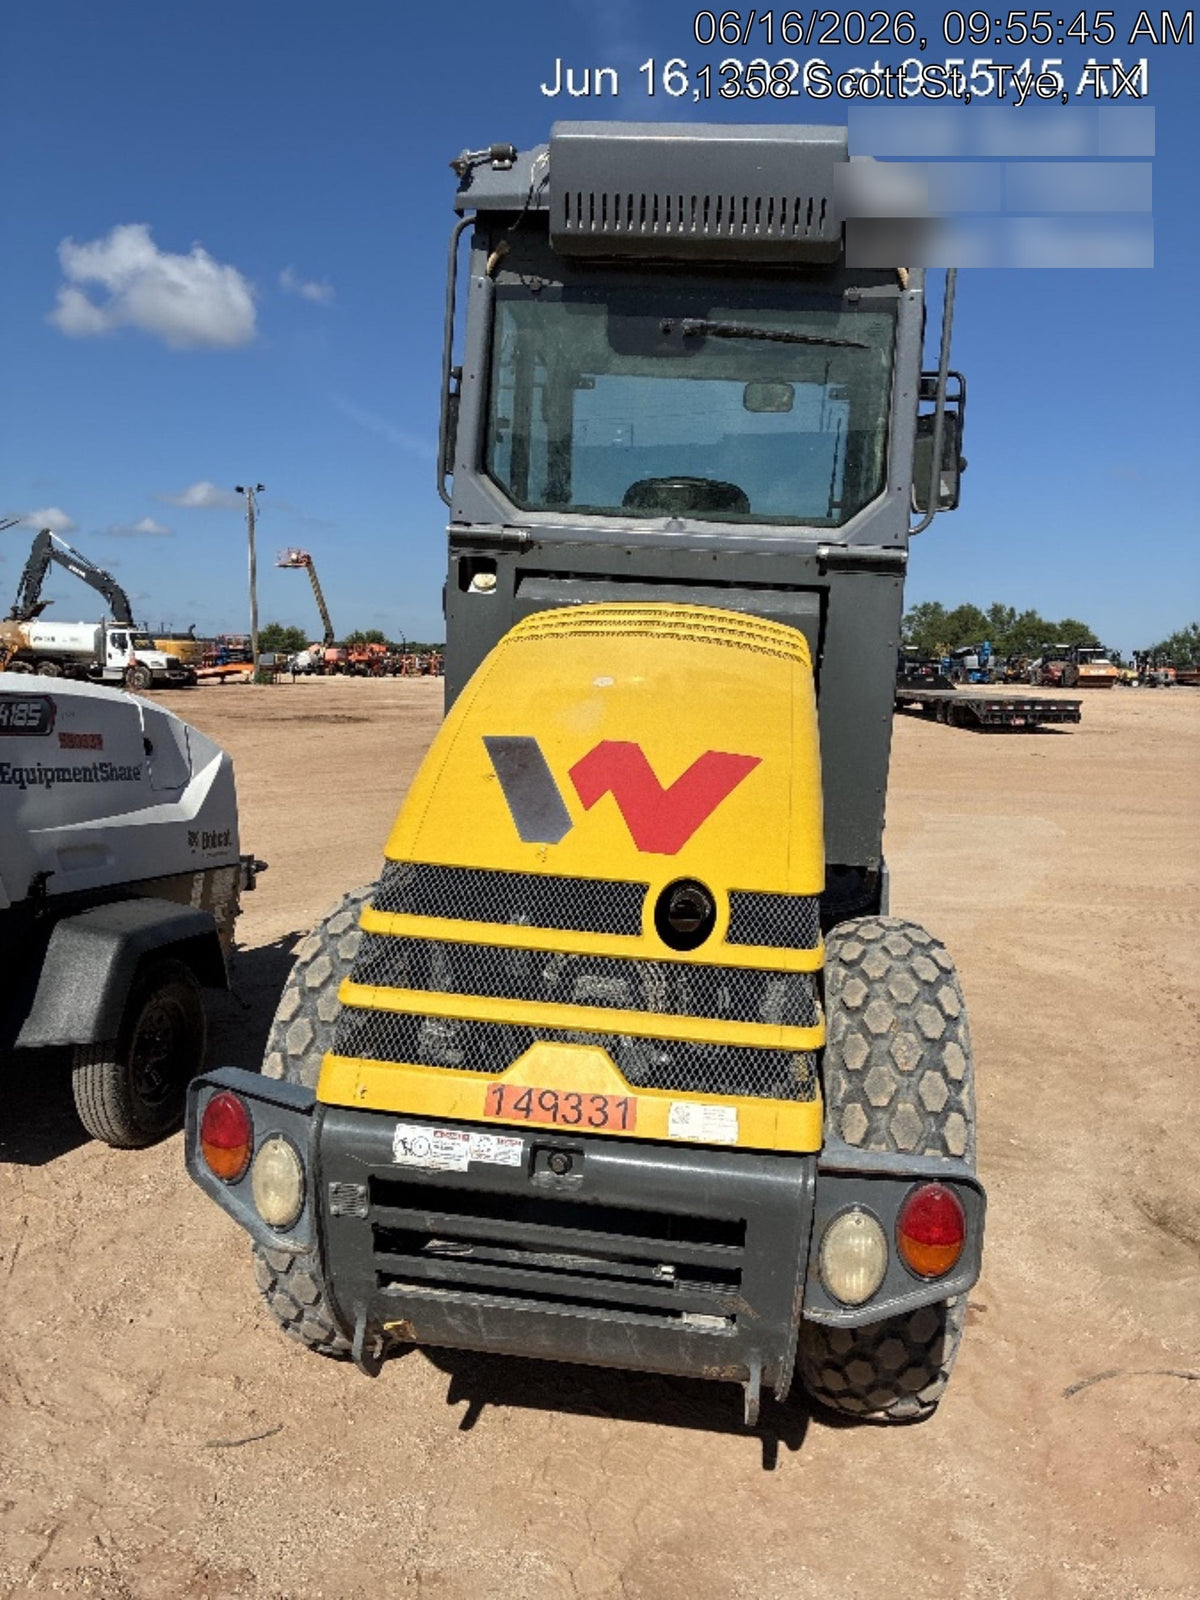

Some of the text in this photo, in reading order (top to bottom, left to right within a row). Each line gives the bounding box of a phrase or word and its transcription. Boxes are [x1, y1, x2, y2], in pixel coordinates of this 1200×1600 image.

[0, 762, 142, 790] EquipmentShare
[202, 828, 230, 849] Bobcat
[491, 1084, 630, 1129] 149331
